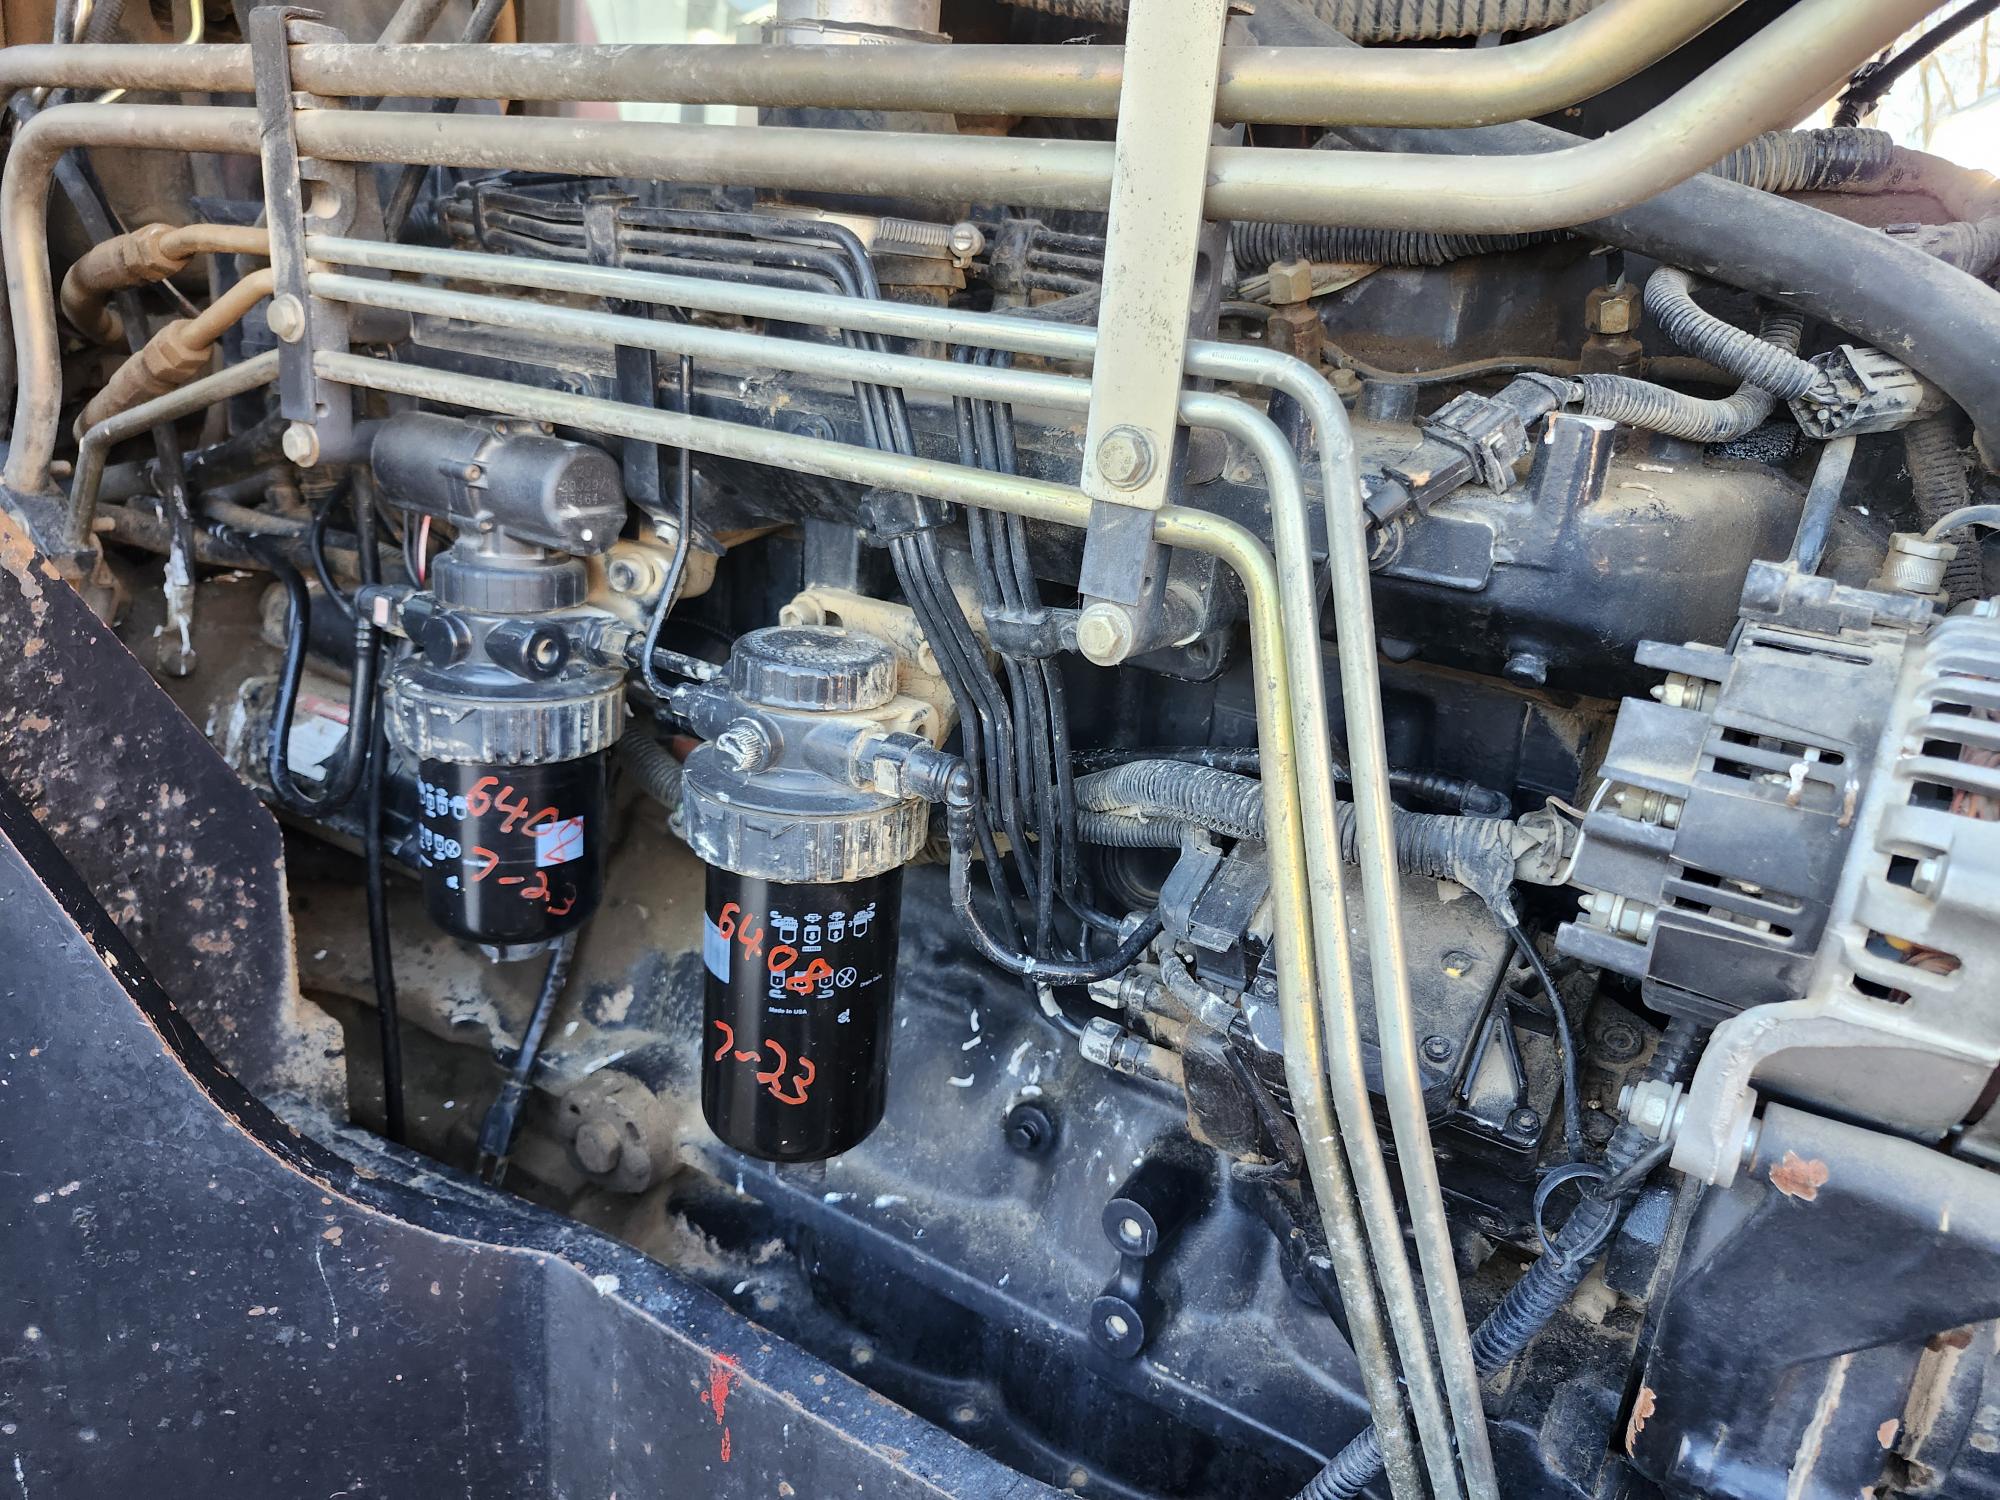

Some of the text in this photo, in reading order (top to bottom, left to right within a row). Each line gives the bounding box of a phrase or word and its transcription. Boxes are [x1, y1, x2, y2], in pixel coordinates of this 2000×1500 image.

[466, 776, 584, 863] 6408
[471, 845, 577, 916] 7-23
[718, 902, 833, 993] 6408
[768, 1006, 785, 1014] Made
[713, 1020, 816, 1105] 7-23
